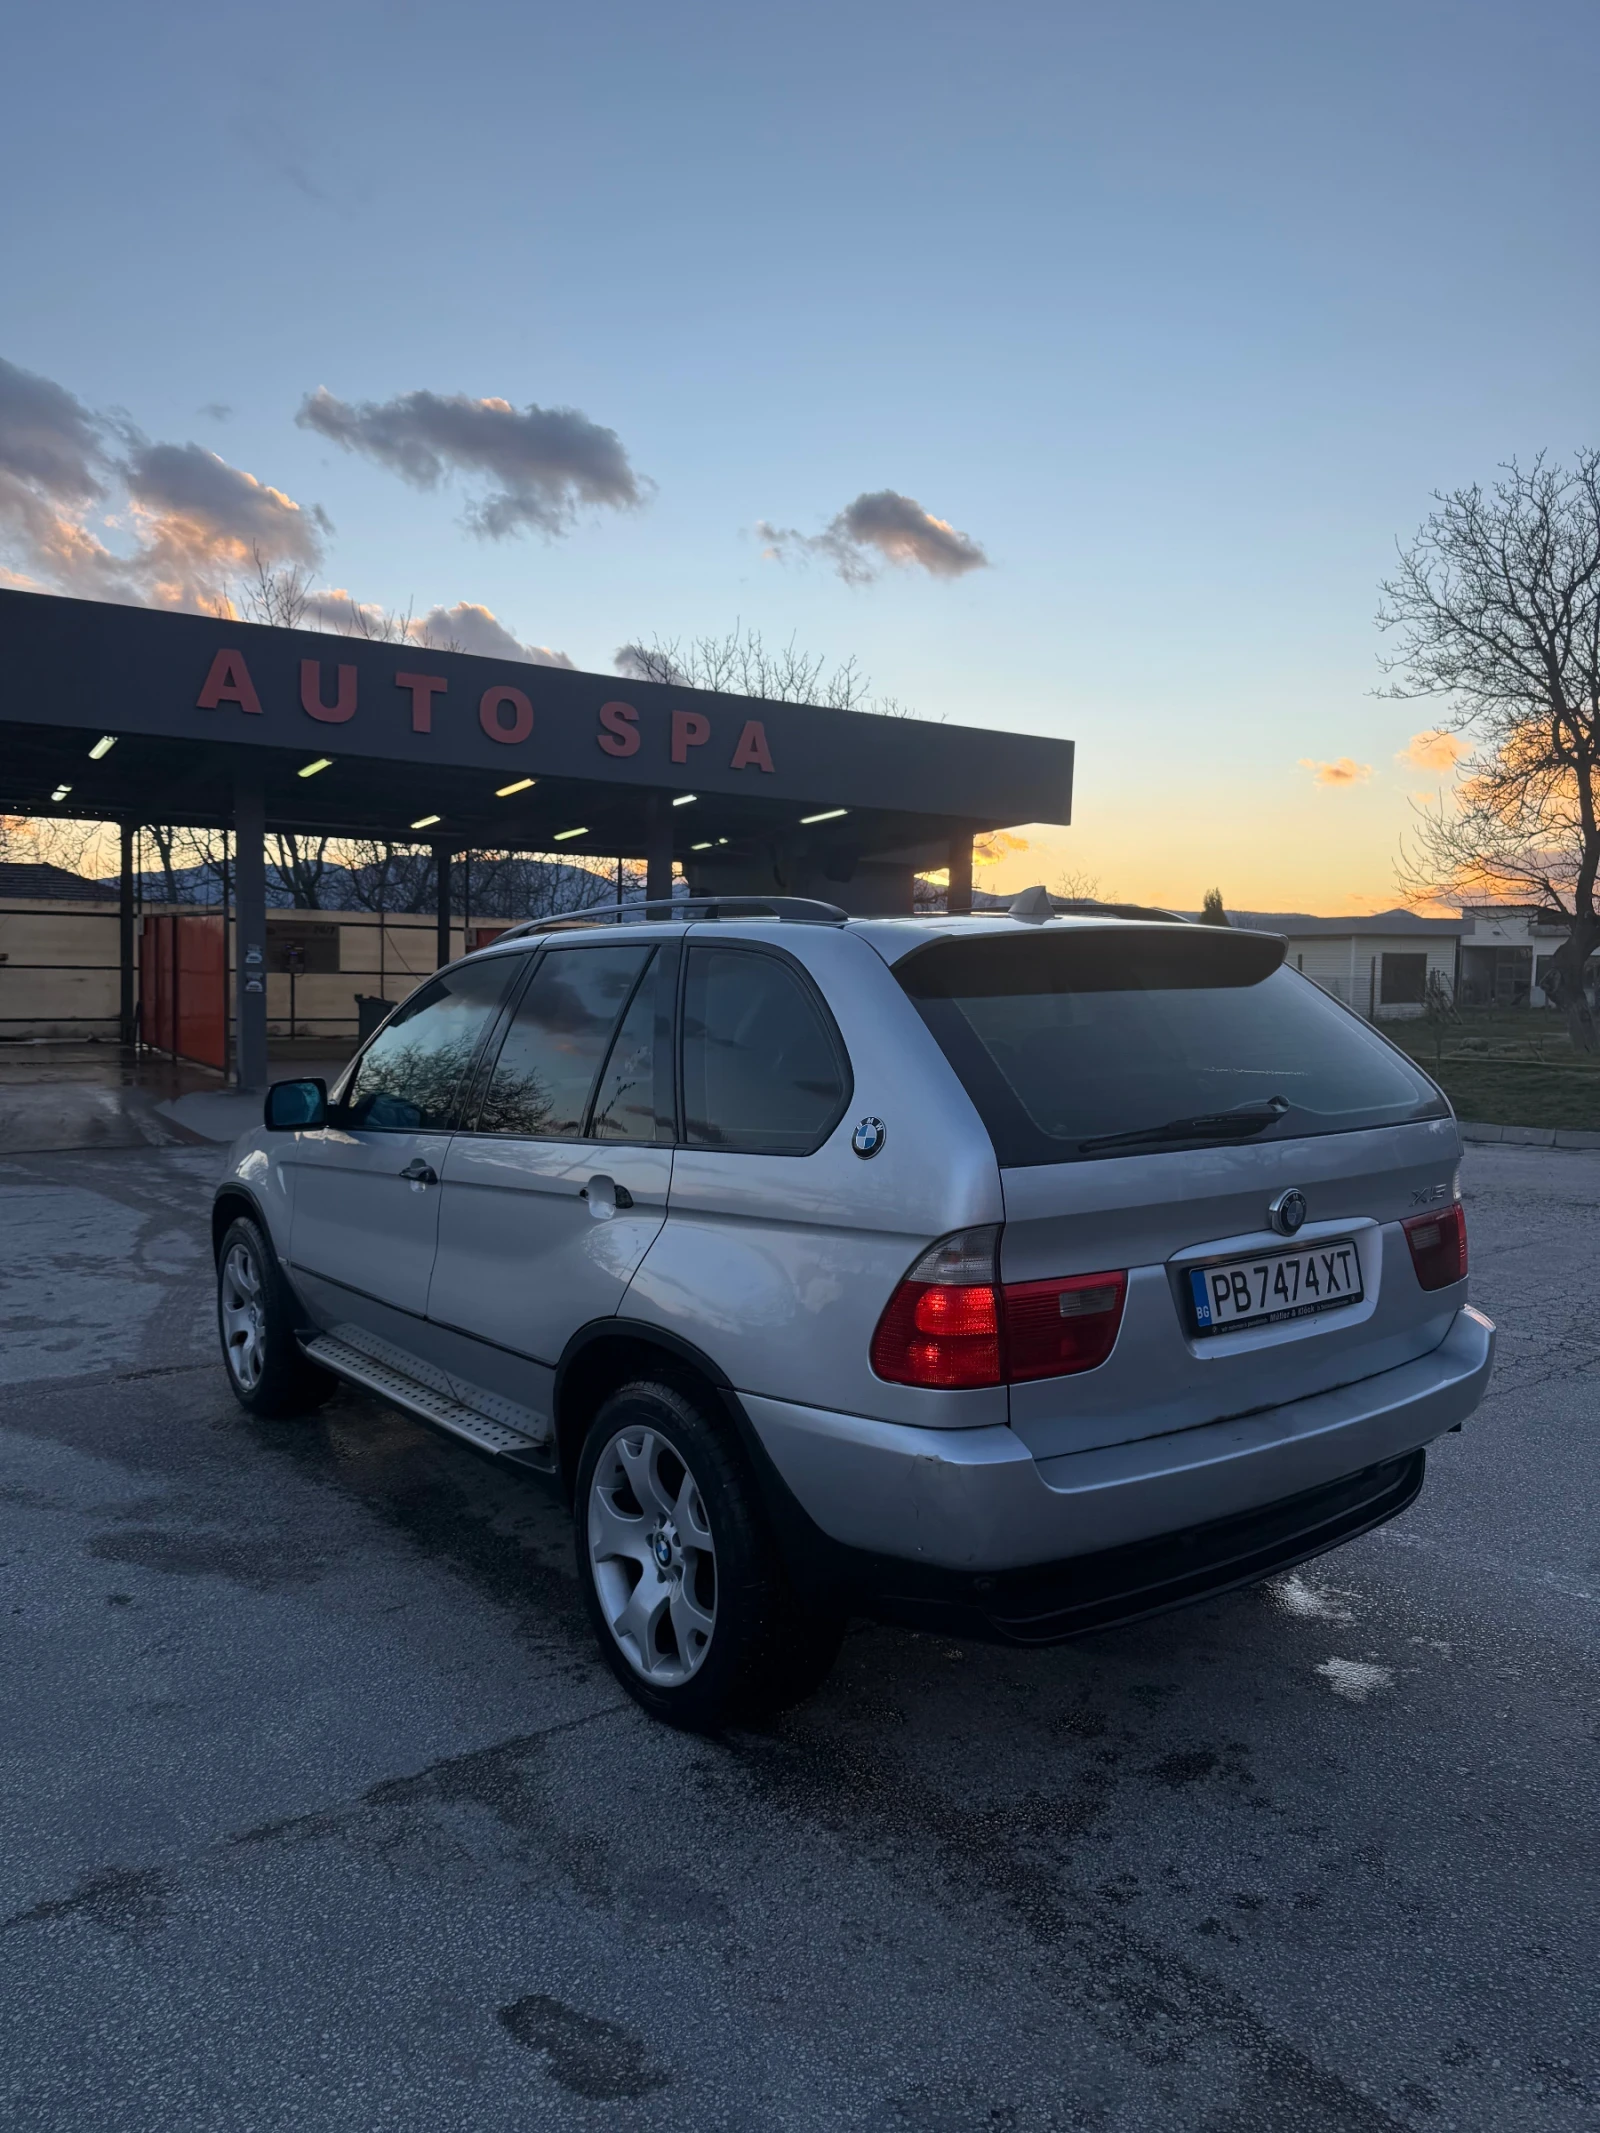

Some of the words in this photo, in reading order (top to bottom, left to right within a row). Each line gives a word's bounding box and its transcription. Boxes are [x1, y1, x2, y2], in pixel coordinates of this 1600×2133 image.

[196, 648, 534, 744] AUTO
[597, 701, 776, 774] SPA
[856, 1117, 884, 1132] BMW
[1196, 1306, 1210, 1320] BG
